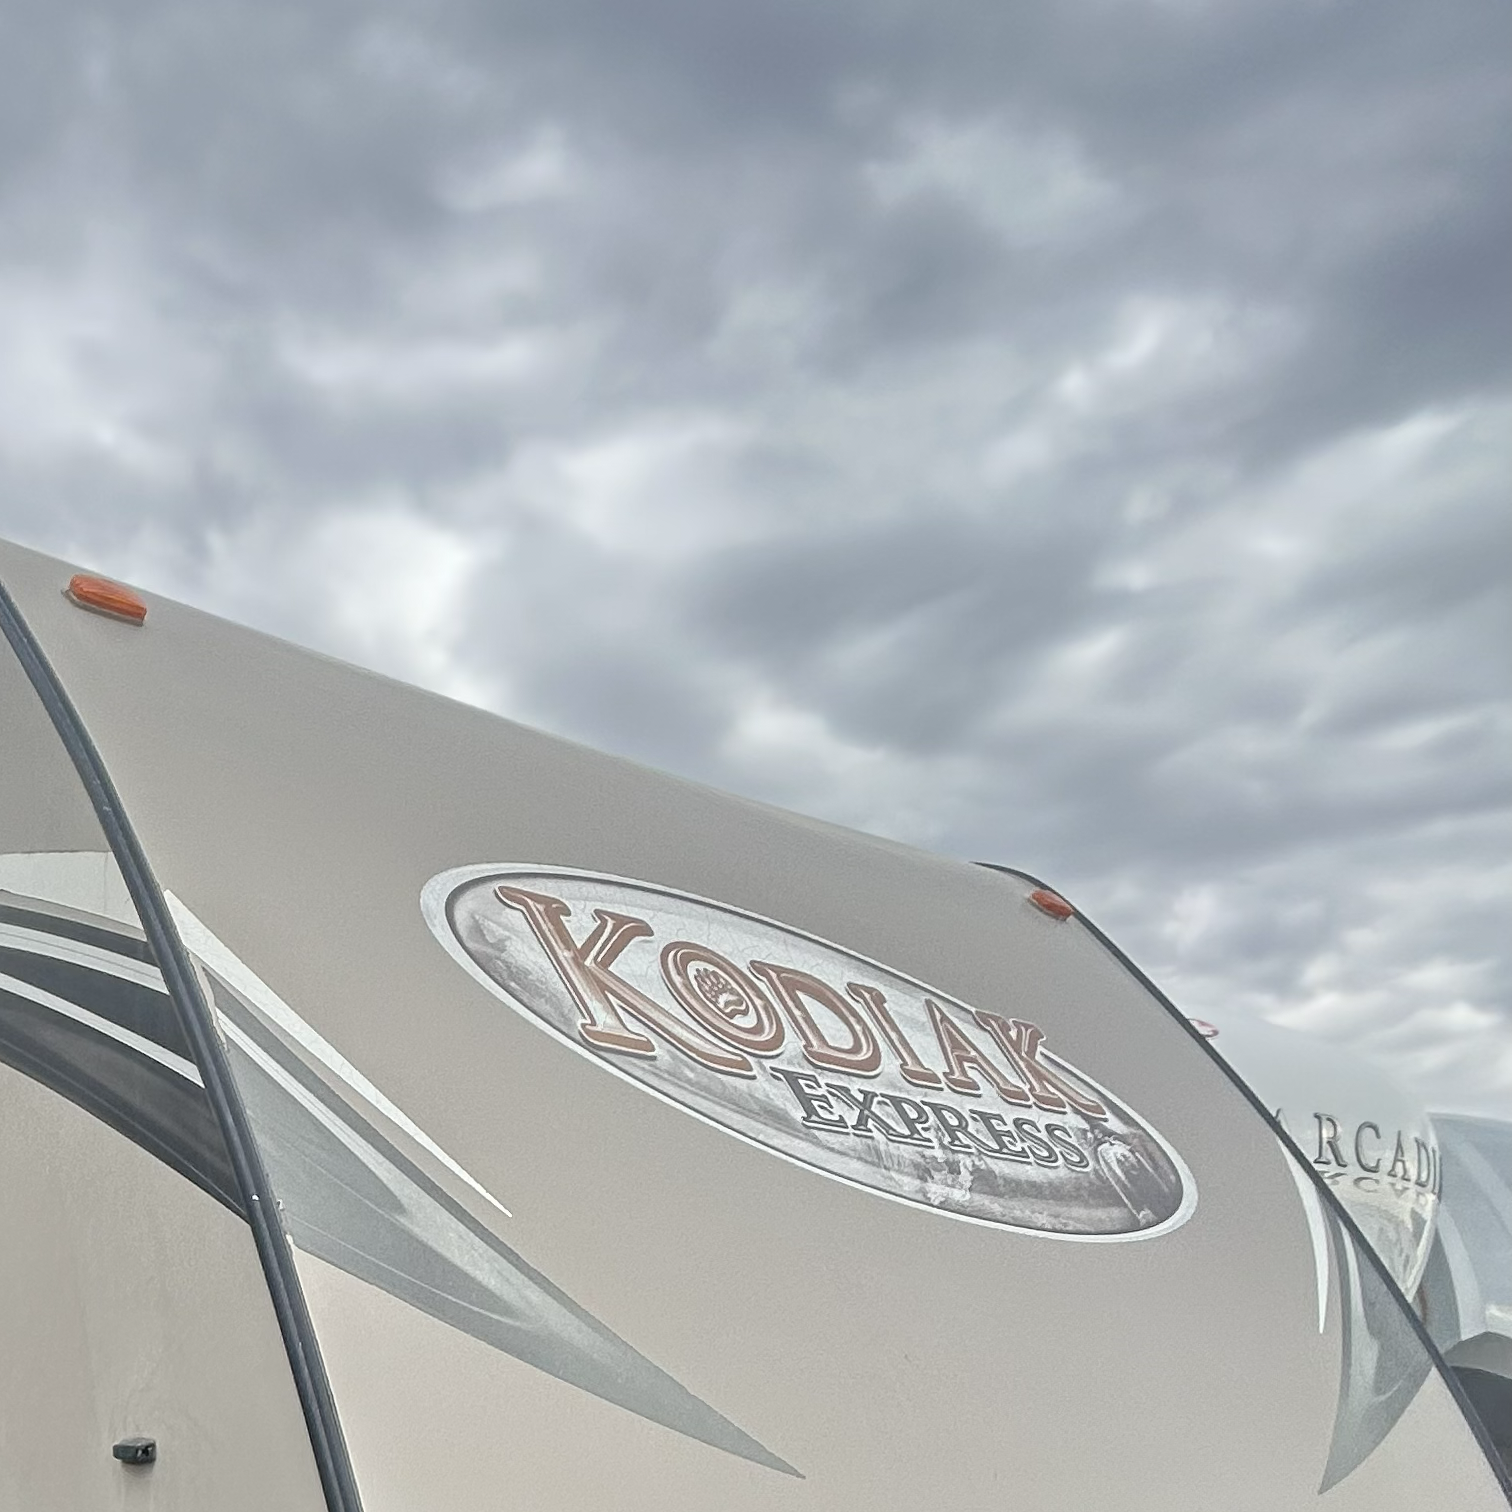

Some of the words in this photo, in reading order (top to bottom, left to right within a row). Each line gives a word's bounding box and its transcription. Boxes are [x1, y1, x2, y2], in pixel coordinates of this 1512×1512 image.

[494, 884, 1109, 1120] KODIAK
[770, 1066, 1091, 1171] EXPRESS
[1274, 1108, 1442, 1203] RCADI
